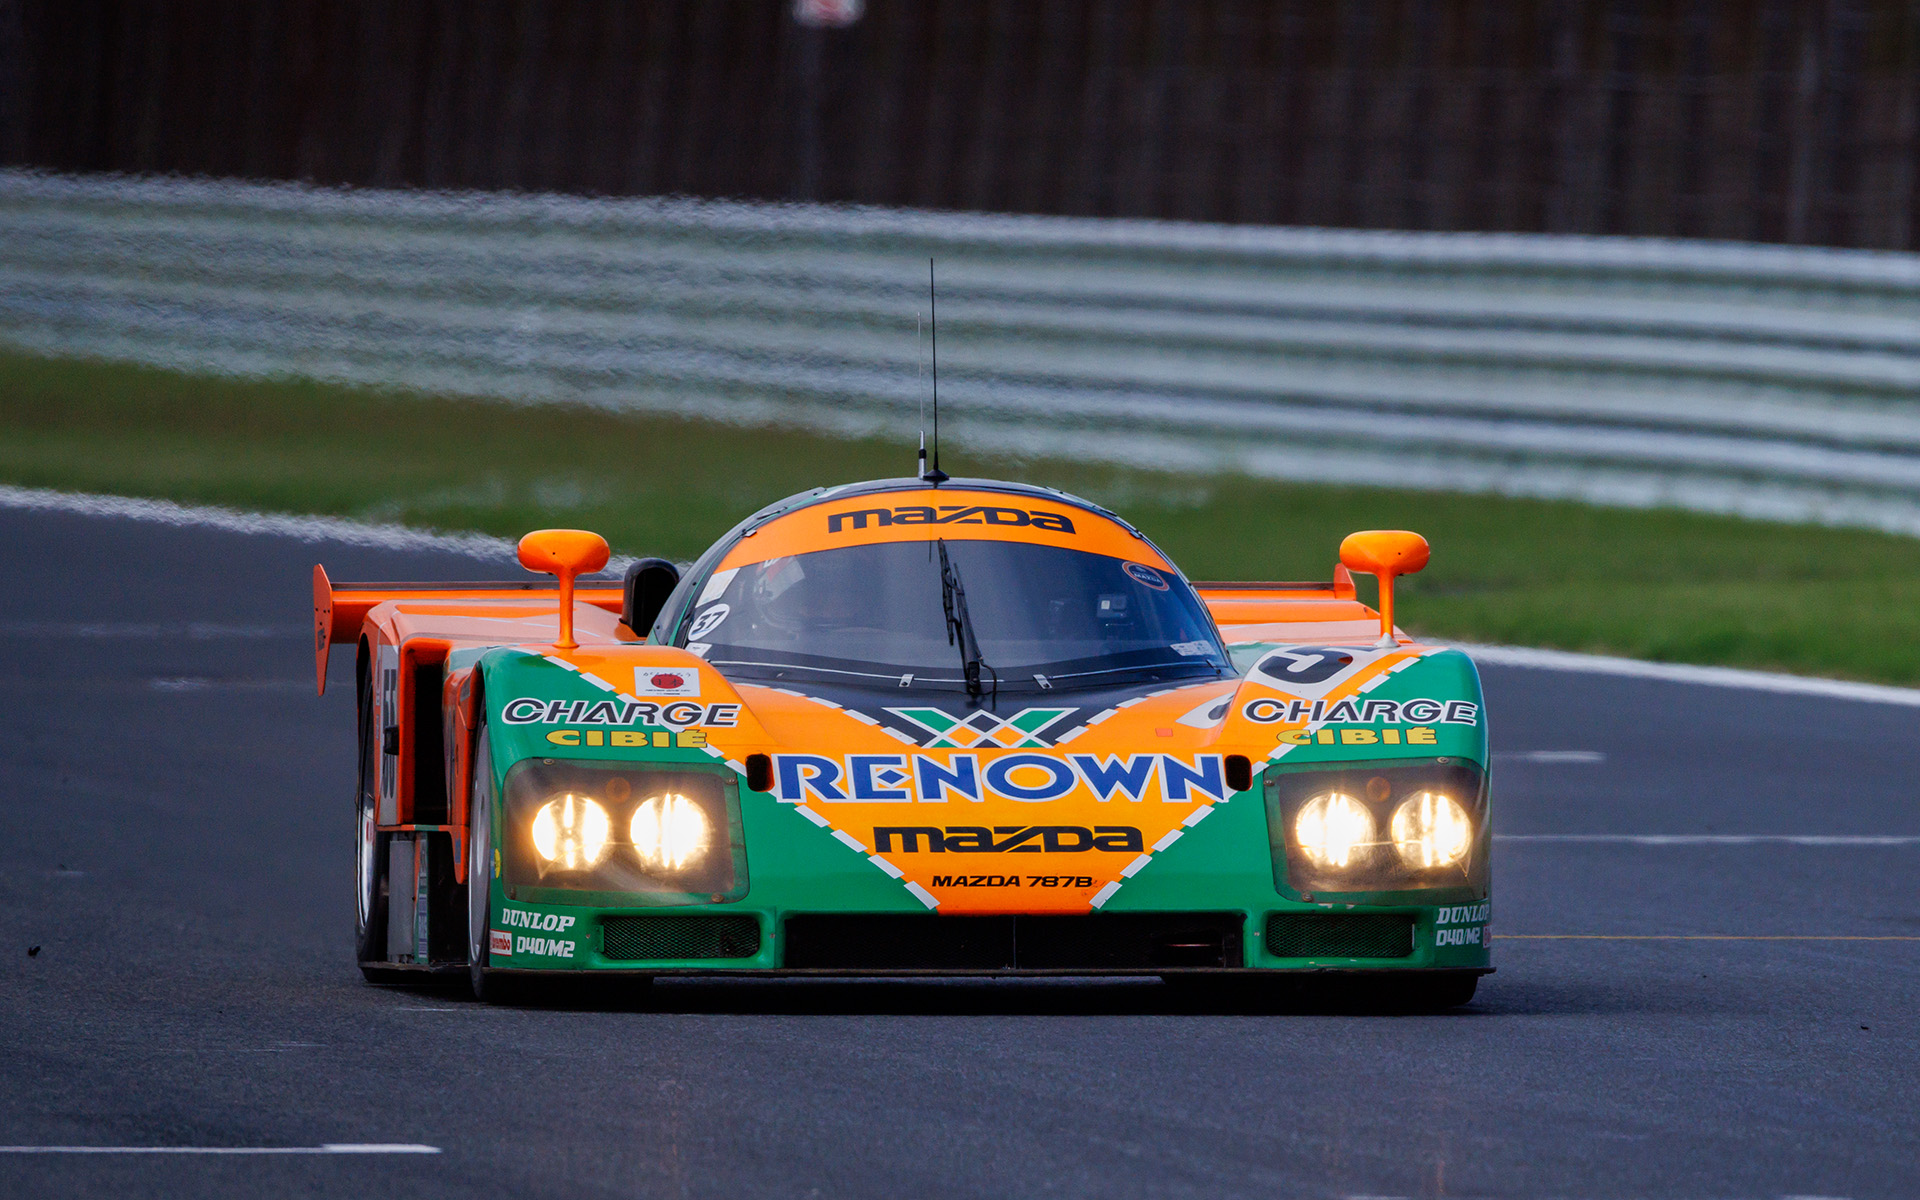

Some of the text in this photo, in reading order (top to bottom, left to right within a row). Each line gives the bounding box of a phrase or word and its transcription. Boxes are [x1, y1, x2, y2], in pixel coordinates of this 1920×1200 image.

[502, 697, 743, 728] CHARGE
[1242, 698, 1479, 727] CHARGE
[545, 729, 708, 748] CIBIÉ
[1276, 726, 1438, 745] CIBIÉ
[771, 753, 1229, 803] RENOWN
[931, 876, 1093, 888] MAZDA 787B
[501, 908, 576, 932] DUNLOP
[516, 936, 576, 957] D40/M2
